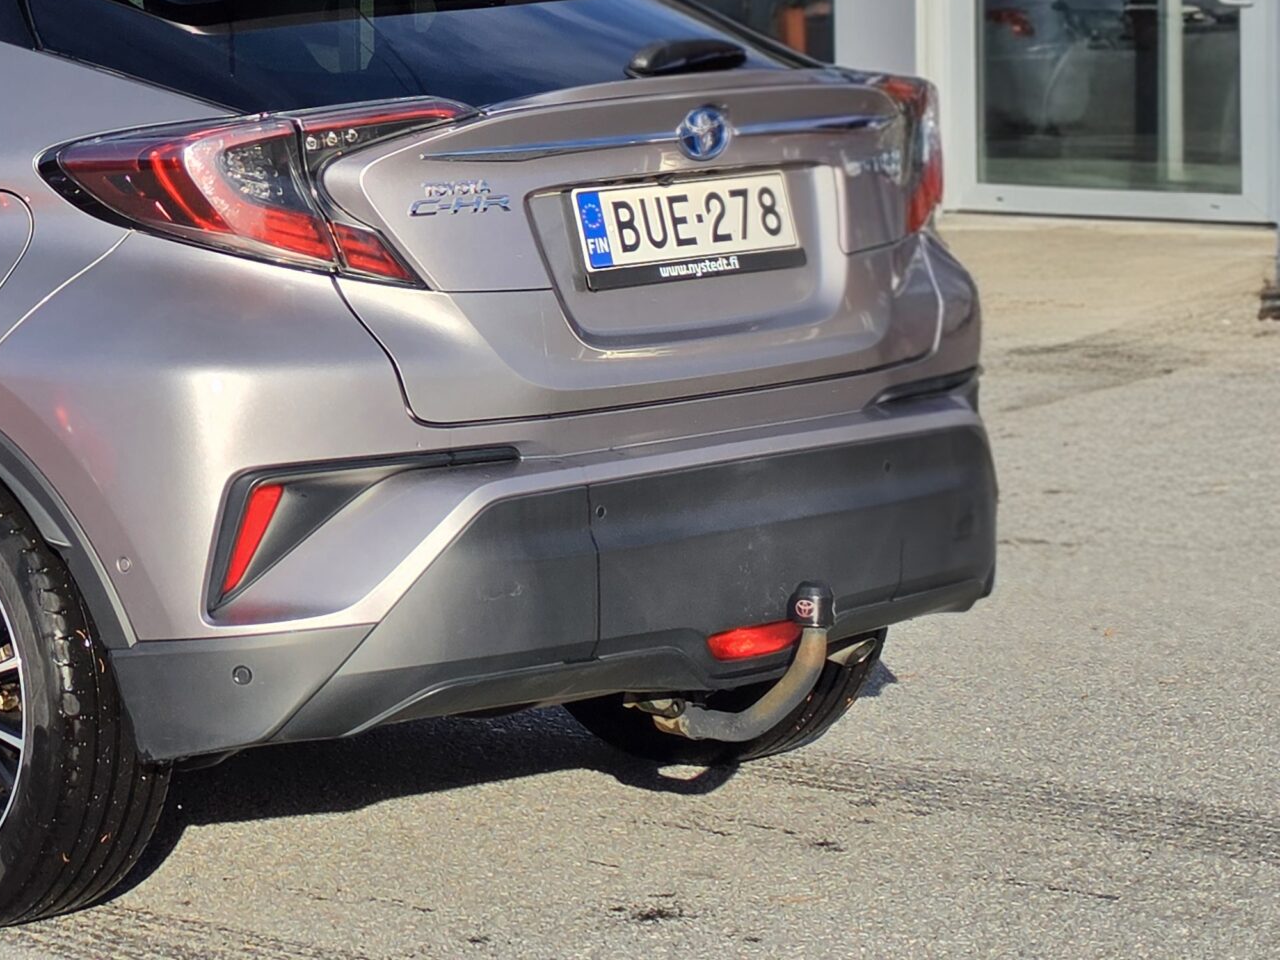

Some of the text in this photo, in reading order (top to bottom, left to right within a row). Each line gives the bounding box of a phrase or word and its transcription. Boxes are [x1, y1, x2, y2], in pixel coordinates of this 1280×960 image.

[421, 179, 491, 197] TOYOTA
[407, 194, 511, 217] C-HR
[611, 186, 782, 253] BUE-278
[587, 236, 610, 256] FIN
[659, 256, 740, 278] www.nystedt.fi
